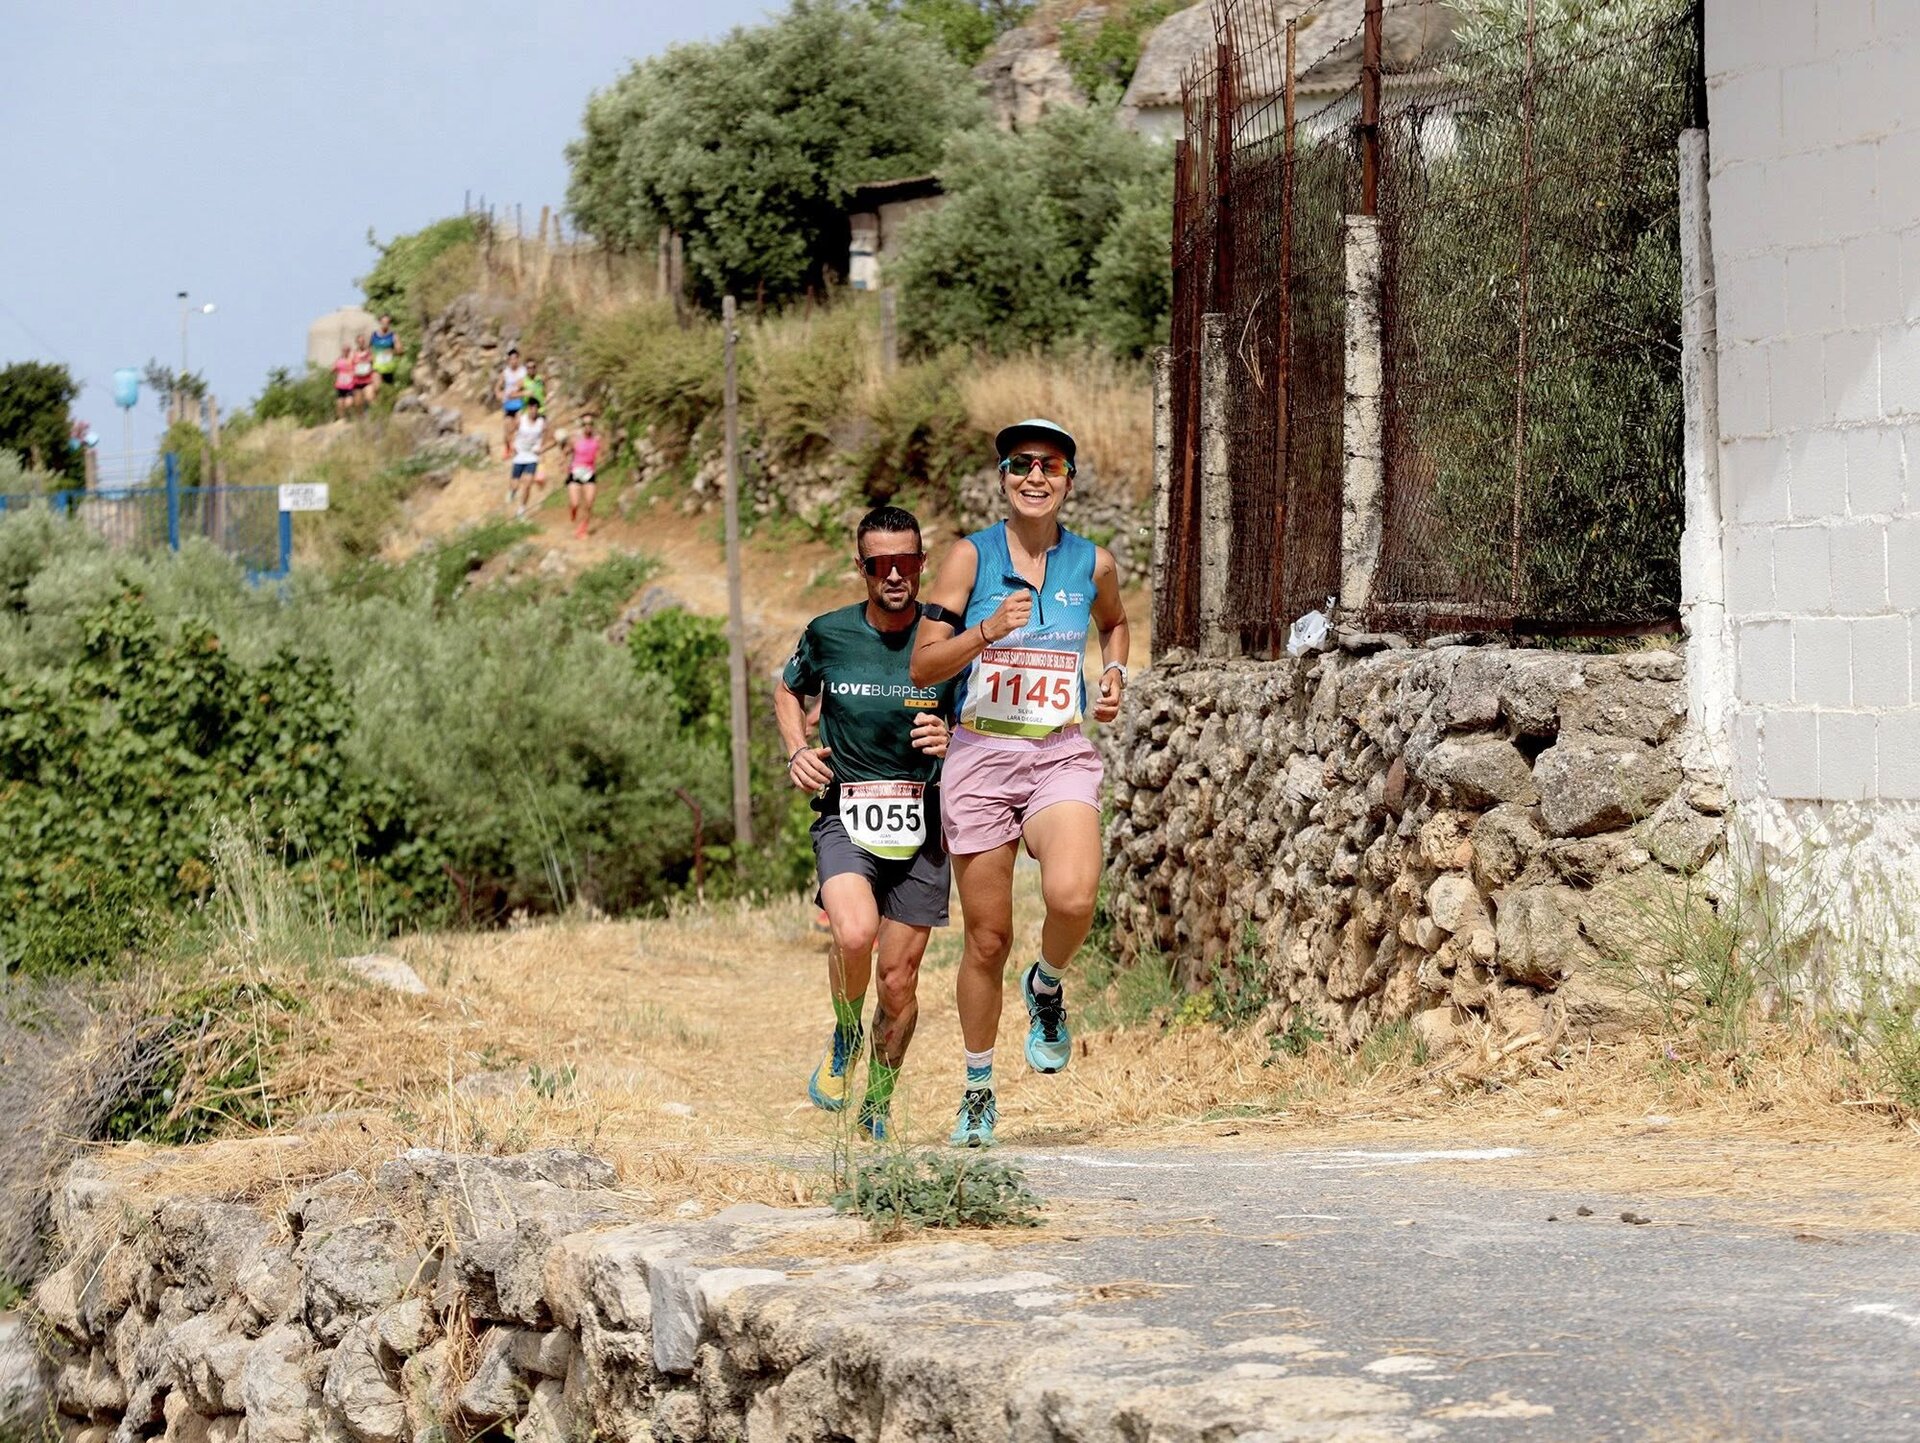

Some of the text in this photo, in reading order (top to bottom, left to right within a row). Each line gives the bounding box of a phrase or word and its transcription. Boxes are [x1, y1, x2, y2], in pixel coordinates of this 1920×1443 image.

[1026, 653, 1047, 667] DOMINGO
[1047, 655, 1054, 668] DE
[830, 681, 937, 700] LOVEBURPEES
[986, 671, 1071, 711] 1145
[845, 804, 921, 832] 1055
